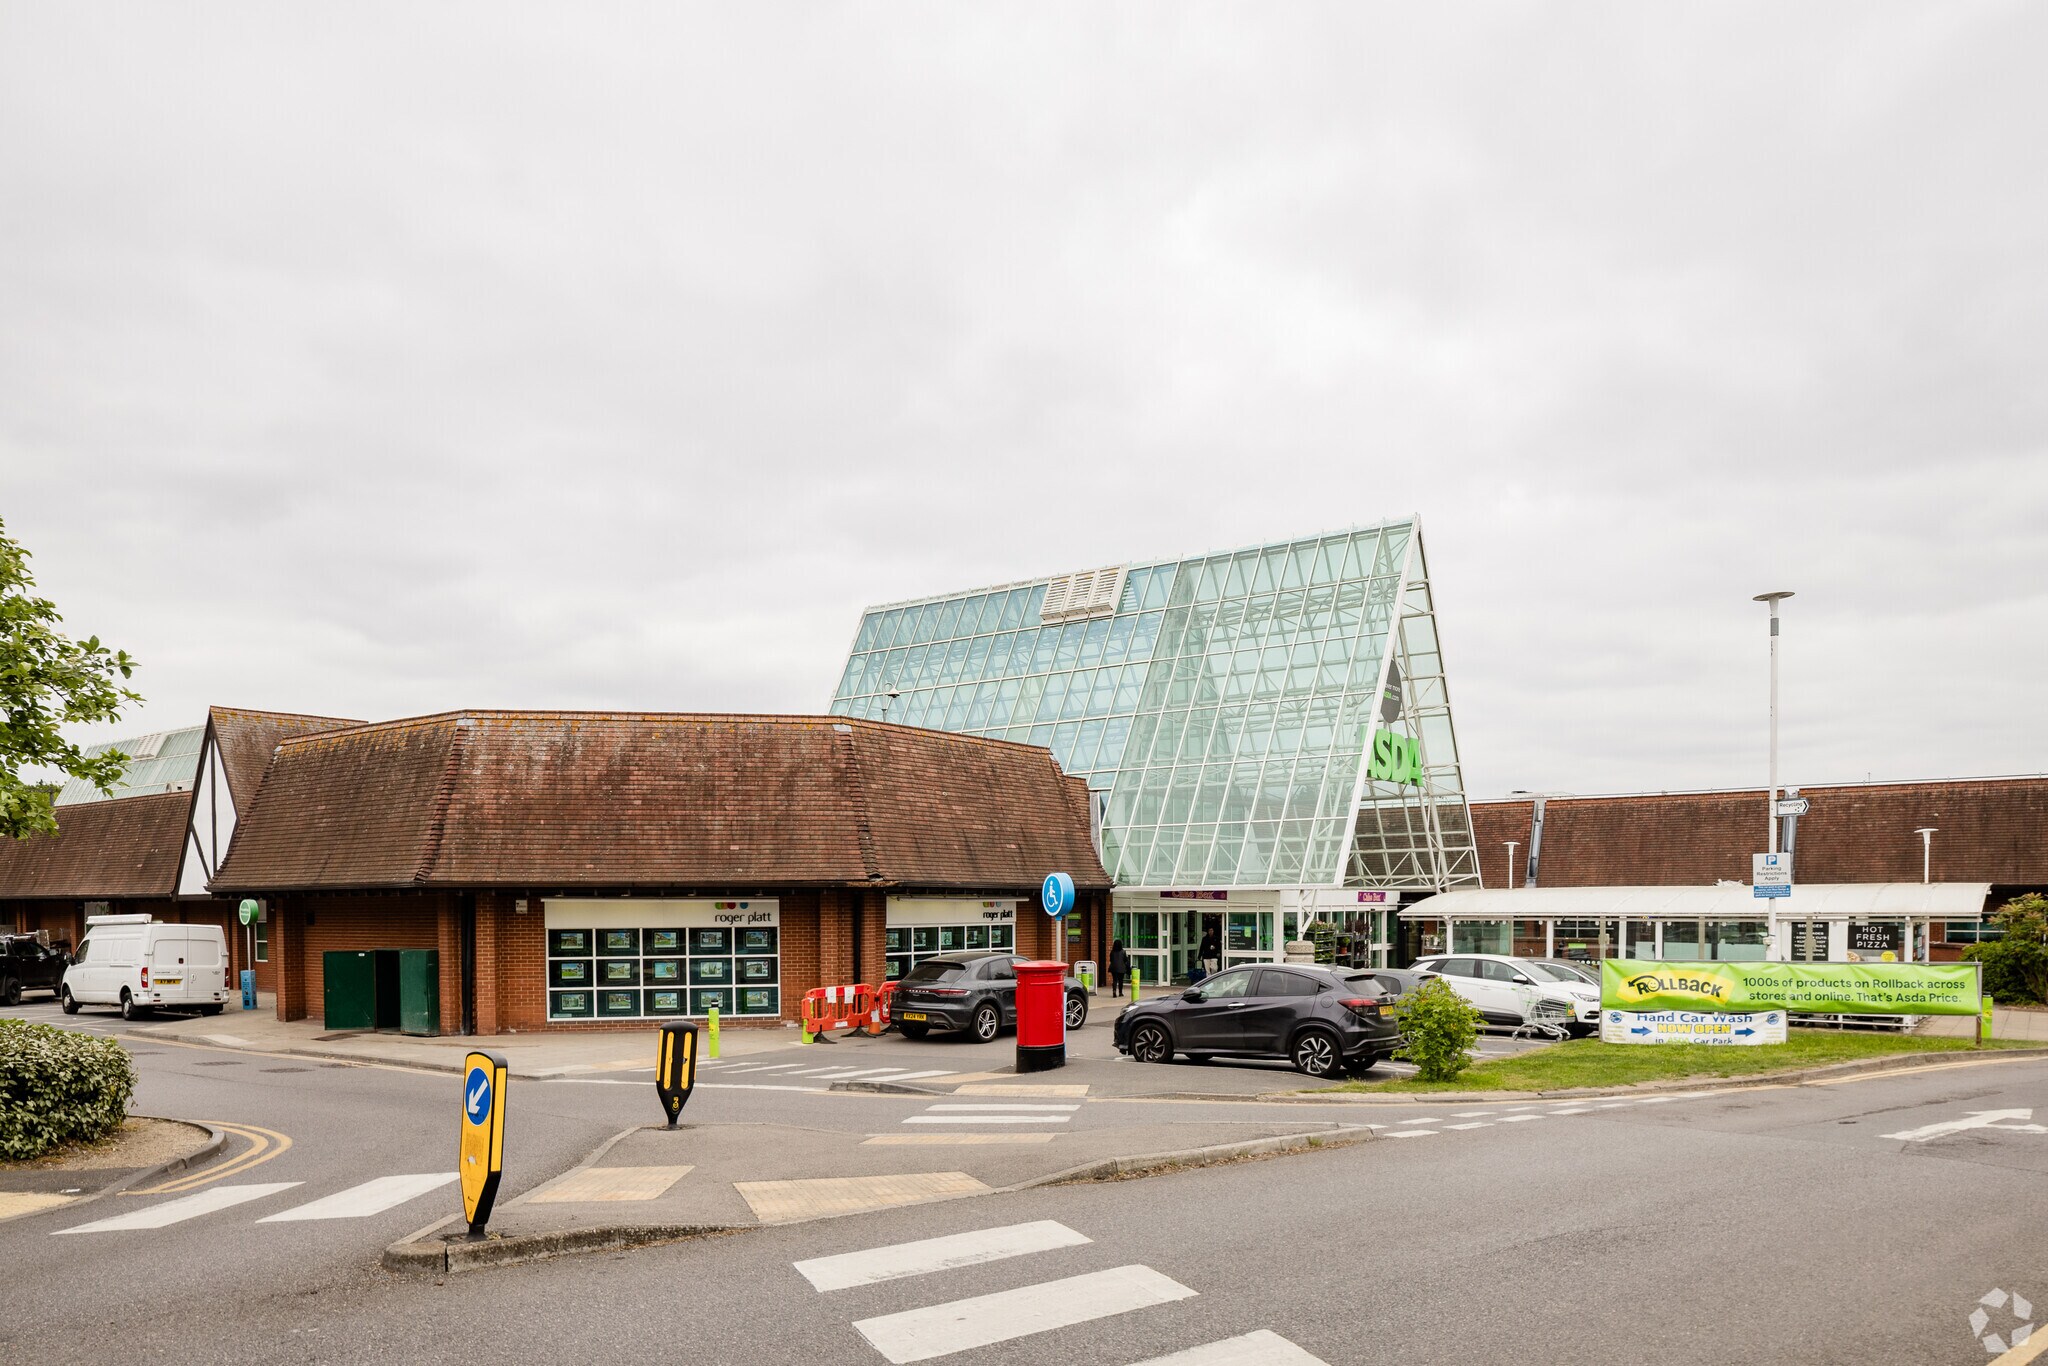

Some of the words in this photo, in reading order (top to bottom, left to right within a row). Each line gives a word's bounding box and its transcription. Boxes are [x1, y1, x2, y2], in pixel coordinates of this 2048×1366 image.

[714, 913, 745, 925] roger
[747, 911, 772, 925] platt
[982, 911, 1000, 921] roger
[1000, 909, 1013, 921] platt
[1743, 977, 1779, 987] 1000s
[1782, 977, 1793, 987] of
[1796, 978, 1852, 990] products
[1854, 980, 1870, 988] on
[1873, 978, 1924, 989] Rollback
[1927, 980, 1966, 989] across
[1749, 992, 1787, 1001] stores
[1789, 991, 1812, 1001] and
[1814, 992, 1854, 1002] online.
[1856, 992, 1893, 1002] That's
[1896, 993, 1926, 1003] Asda
[1929, 993, 1962, 1003] Price.
[1636, 1012, 1675, 1023] Hand
[1680, 1012, 1705, 1023] Car
[1713, 1012, 1753, 1023] Wash
[1657, 1023, 1693, 1034] NOW
[1693, 1023, 1731, 1034] OPEN
